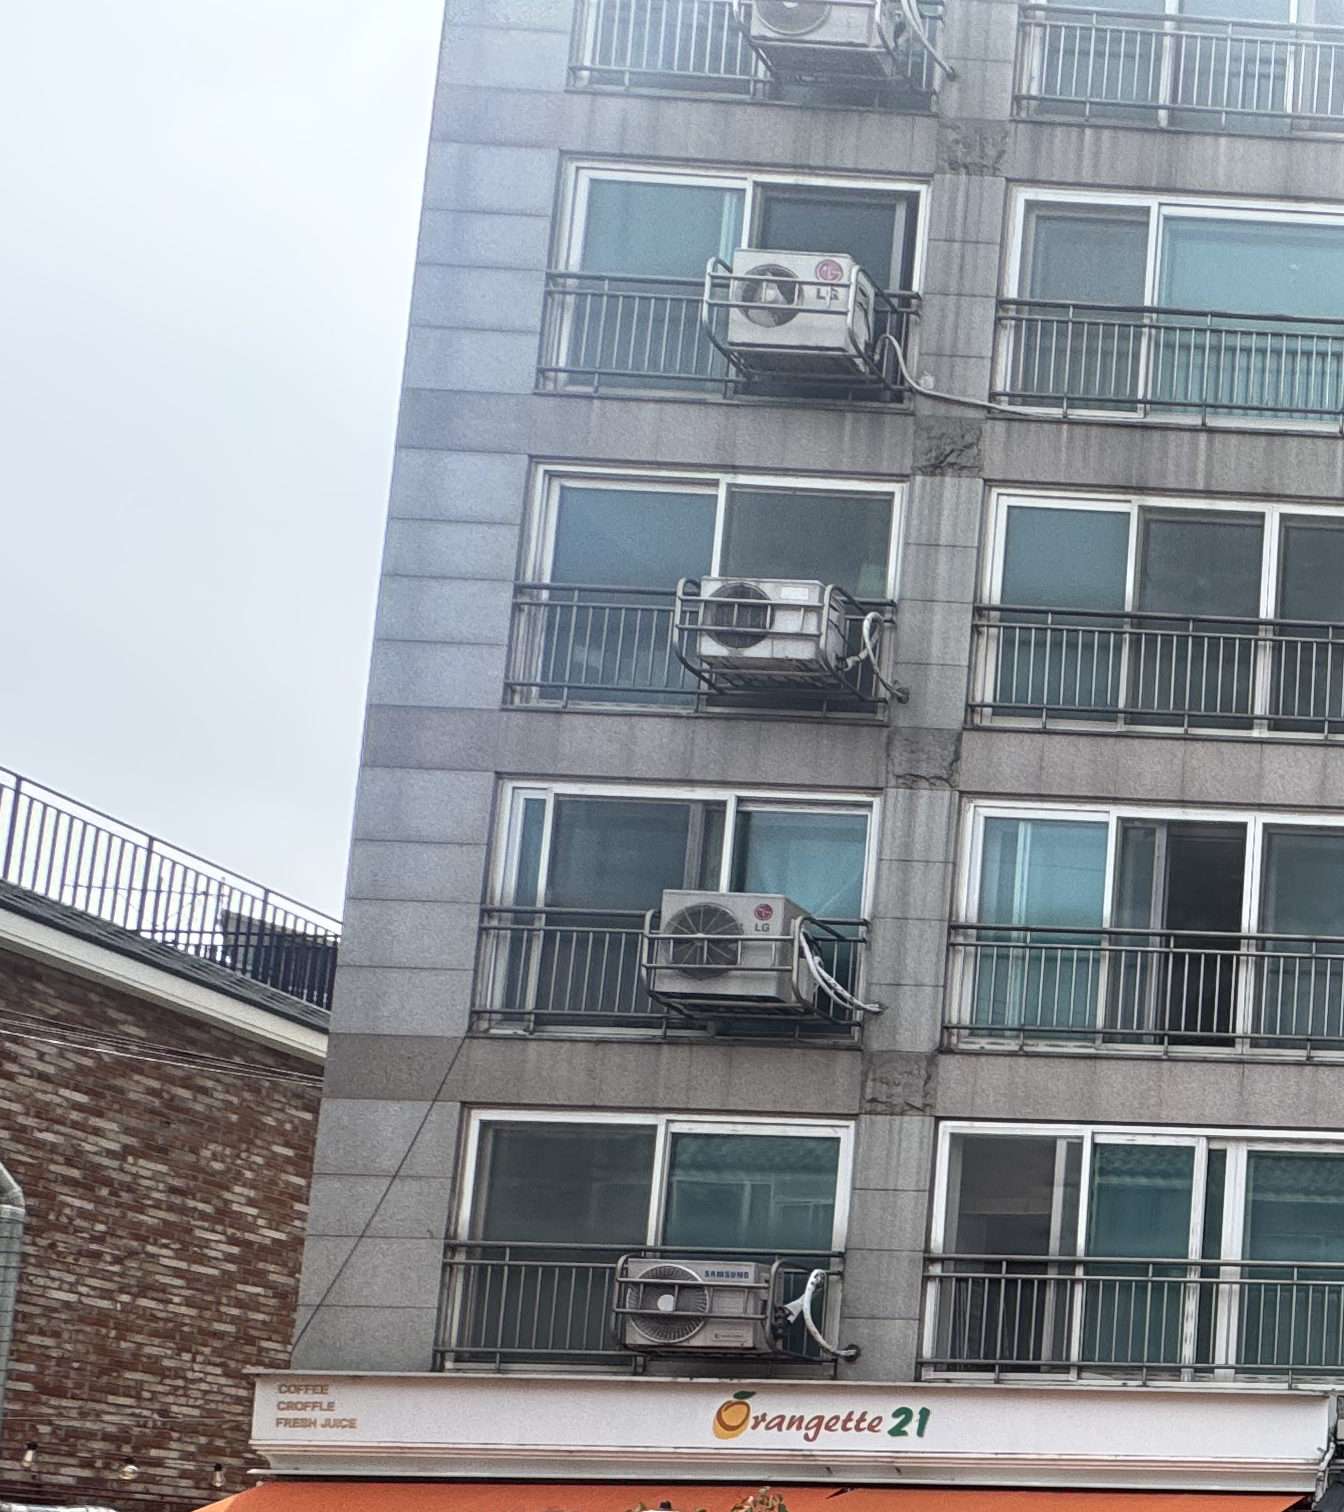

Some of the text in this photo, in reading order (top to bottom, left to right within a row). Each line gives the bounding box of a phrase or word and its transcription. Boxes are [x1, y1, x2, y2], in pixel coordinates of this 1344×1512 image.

[755, 923, 770, 932] LG
[704, 1270, 749, 1279] SAMSUNG
[278, 1384, 328, 1395] COFFEE
[277, 1401, 335, 1411] CROFFLE
[276, 1418, 357, 1429] FRESH JUICE
[716, 1399, 930, 1442] Orangette 21
